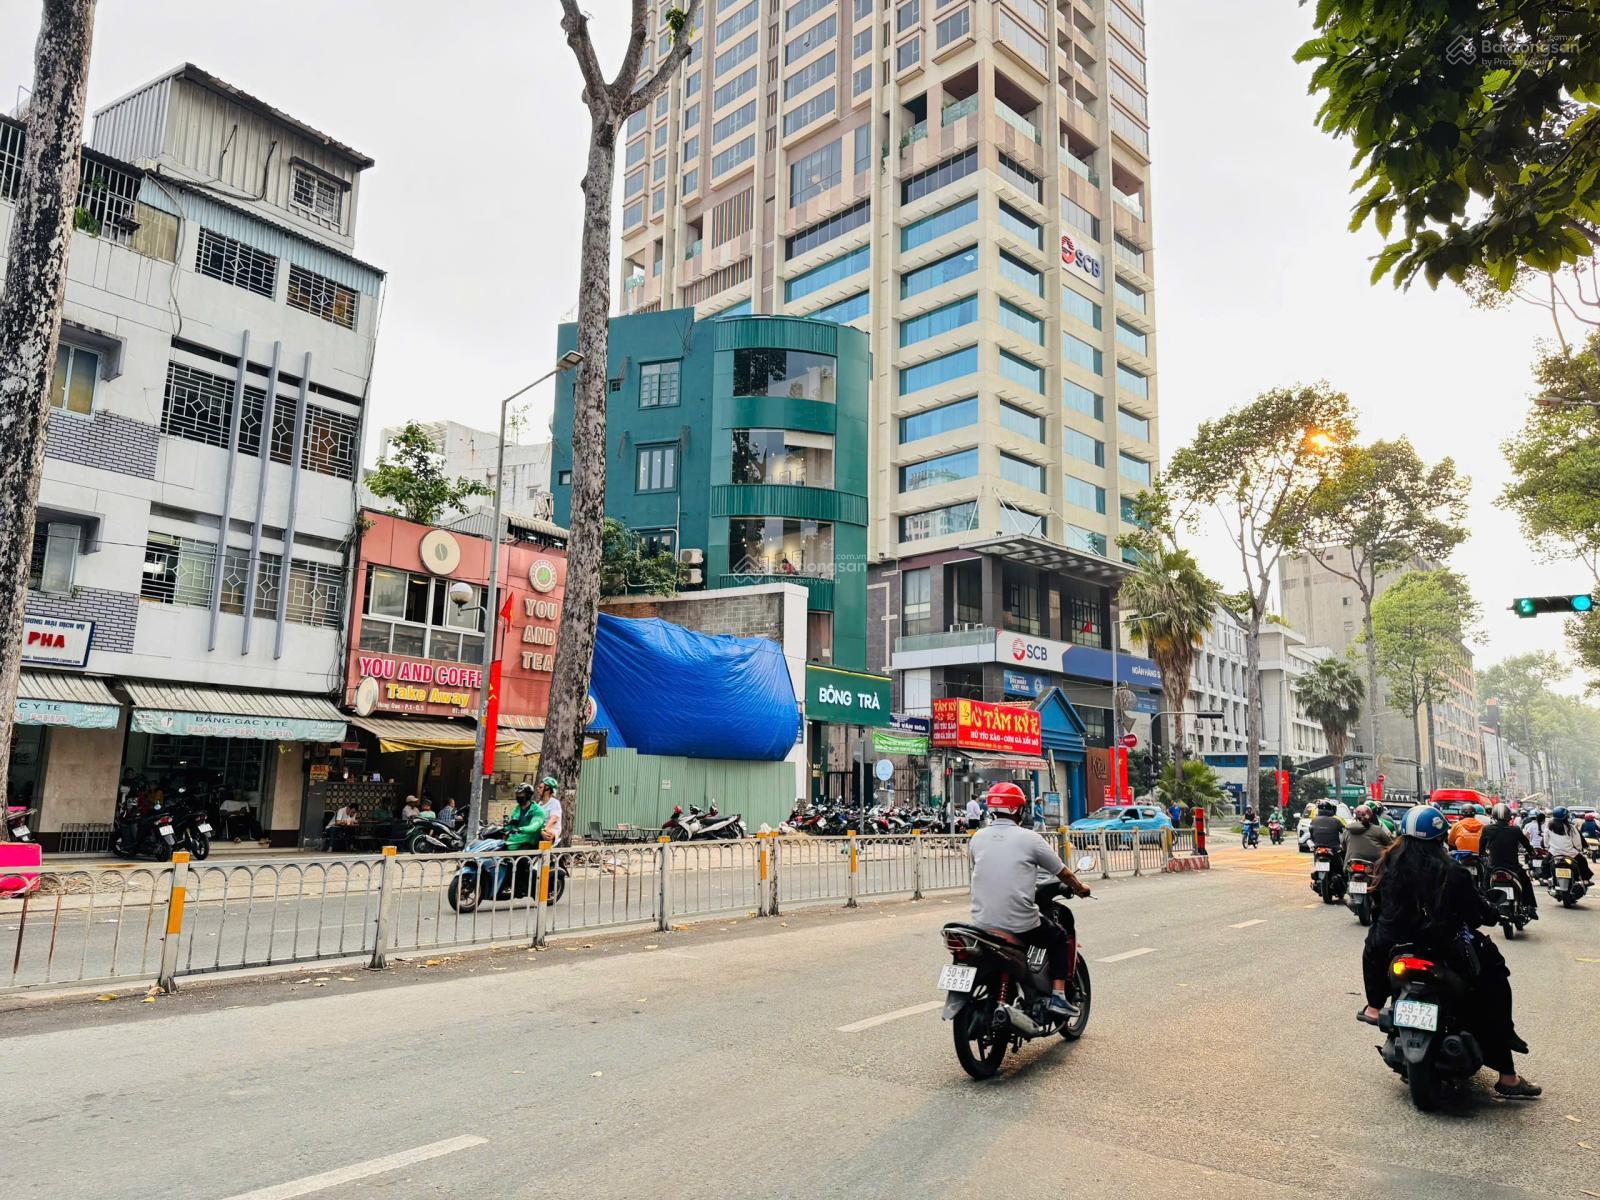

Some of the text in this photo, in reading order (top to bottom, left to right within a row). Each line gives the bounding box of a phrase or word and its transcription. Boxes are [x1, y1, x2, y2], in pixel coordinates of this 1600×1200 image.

[1075, 249, 1100, 278] SCB
[524, 597, 558, 621] YOU
[27, 631, 65, 648] PHA
[522, 624, 556, 646] AND
[521, 651, 554, 672] TEA
[1026, 643, 1048, 661] SCB
[359, 656, 483, 688] YOU AND COFFE
[386, 683, 470, 707] Take Away
[819, 684, 880, 710] BÔNG TRÀ
[983, 707, 1011, 731] TÂM
[1014, 712, 1029, 734] KÝ
